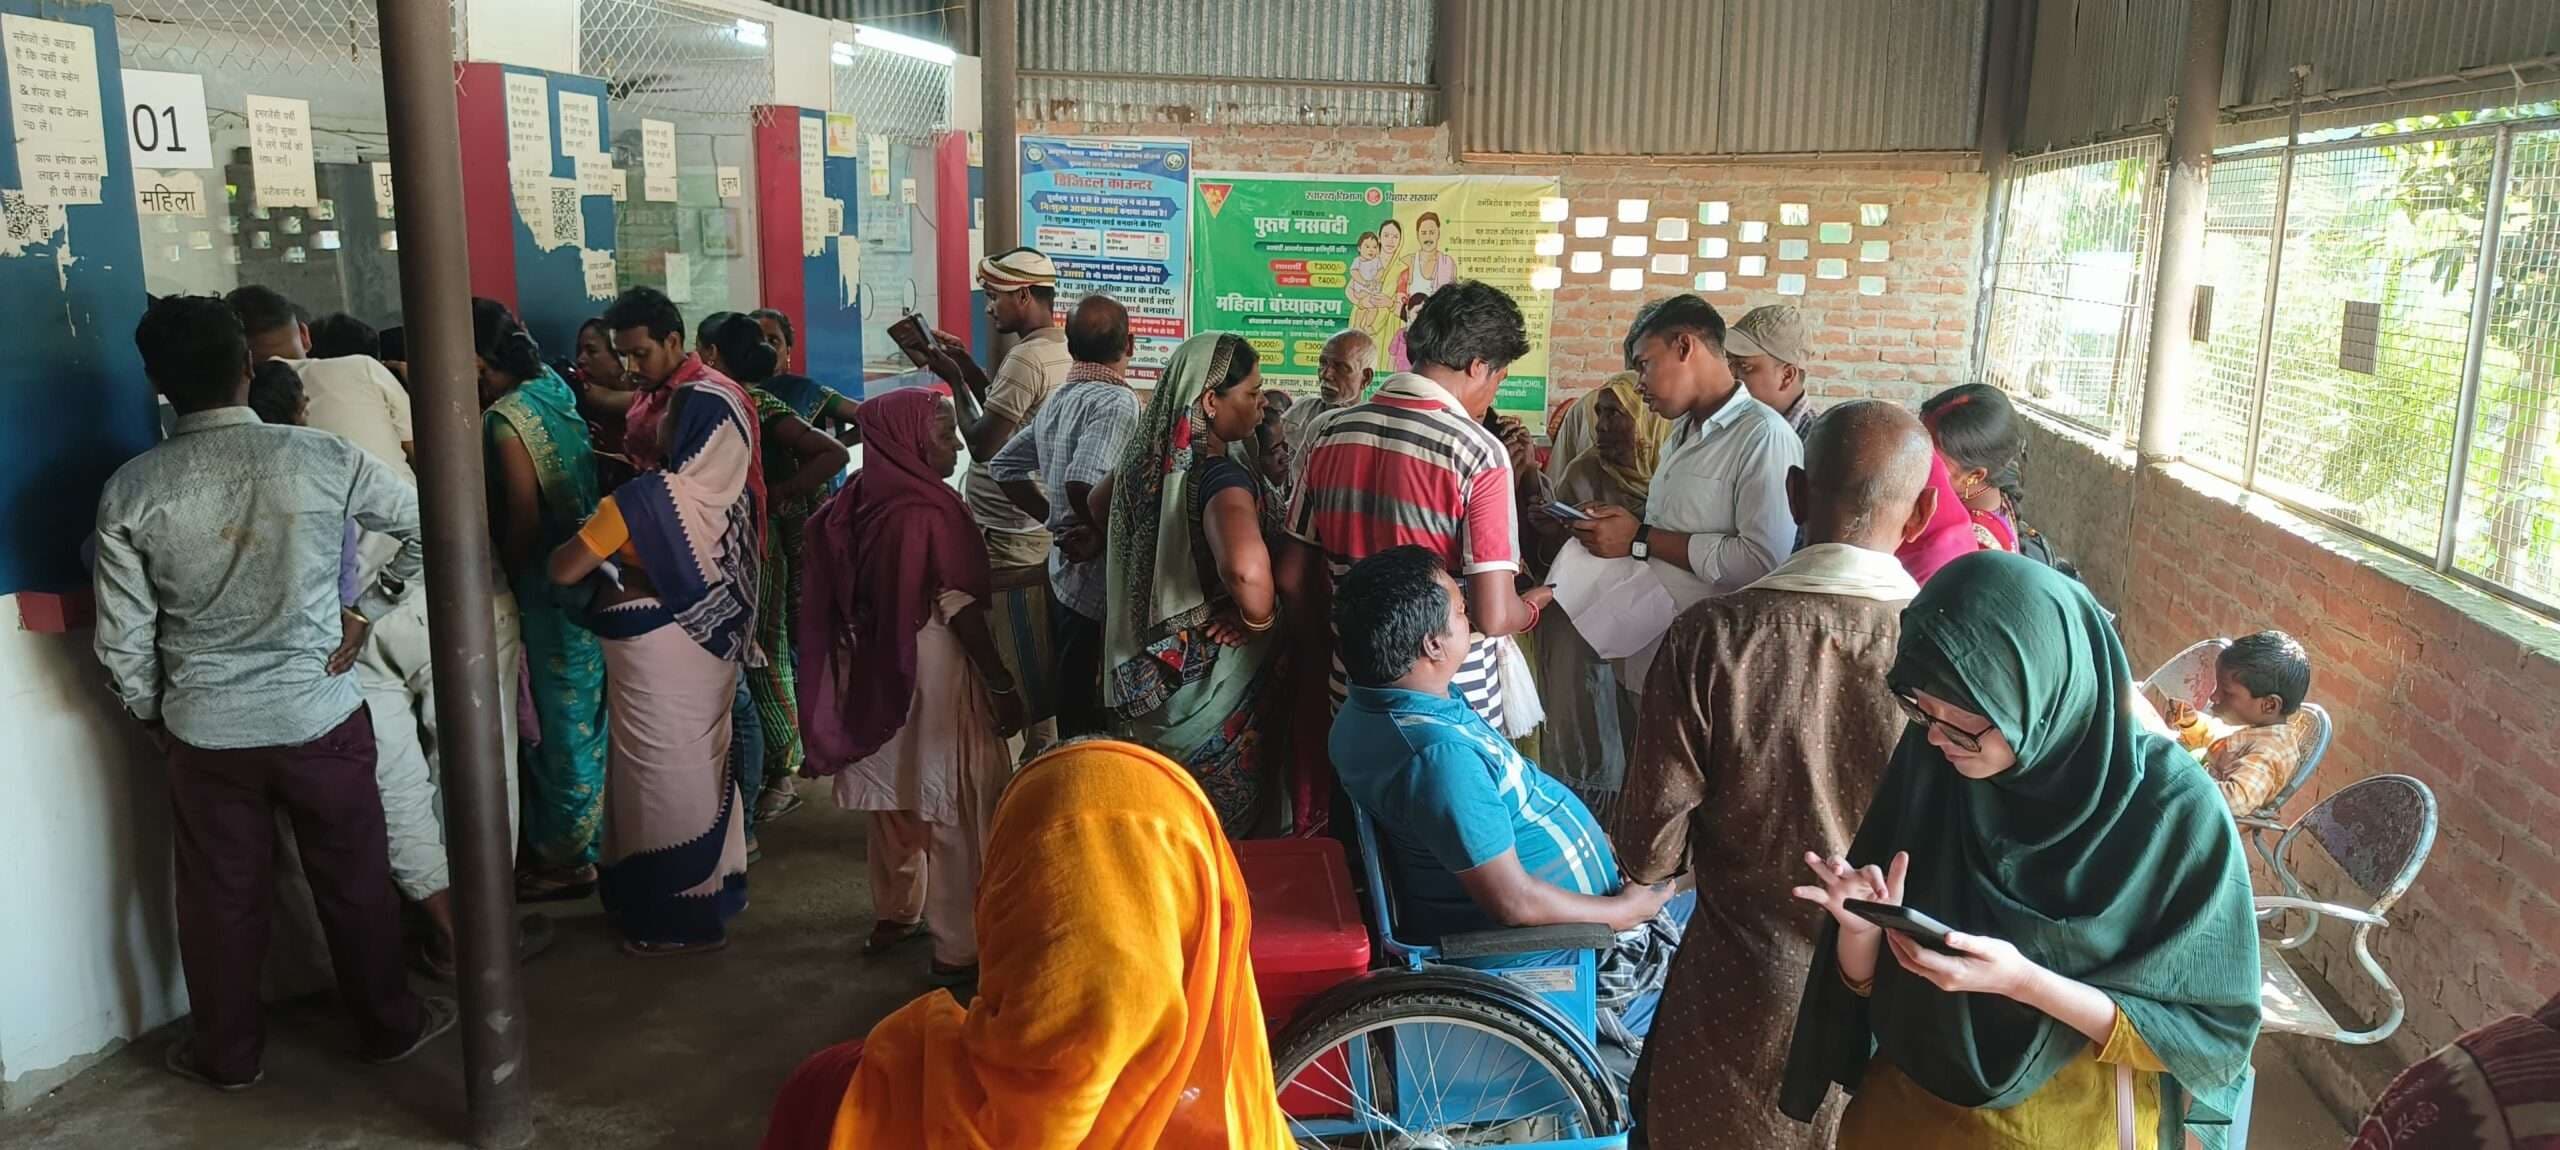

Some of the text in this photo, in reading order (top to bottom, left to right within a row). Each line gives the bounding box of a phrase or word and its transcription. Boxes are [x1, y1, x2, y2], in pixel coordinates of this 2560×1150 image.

[26, 48, 37, 60] कि
[16, 64, 34, 77] लिए
[38, 68, 57, 81] पहले
[20, 84, 28, 95] &
[66, 106, 89, 119] टोकन
[132, 104, 187, 152] 01
[38, 171, 61, 183] लाइन
[1054, 170, 1104, 188] डिजिटल
[49, 185, 58, 198] ही
[139, 183, 196, 212] महिला
[1305, 190, 1438, 202] स्वास्थ्य विभाग बिहार सरकार
[1254, 213, 1349, 238] पुरुष नसबंदी
[1138, 295, 1154, 304] कार्ड
[1216, 293, 1343, 315] महिला बंध्याकरण
